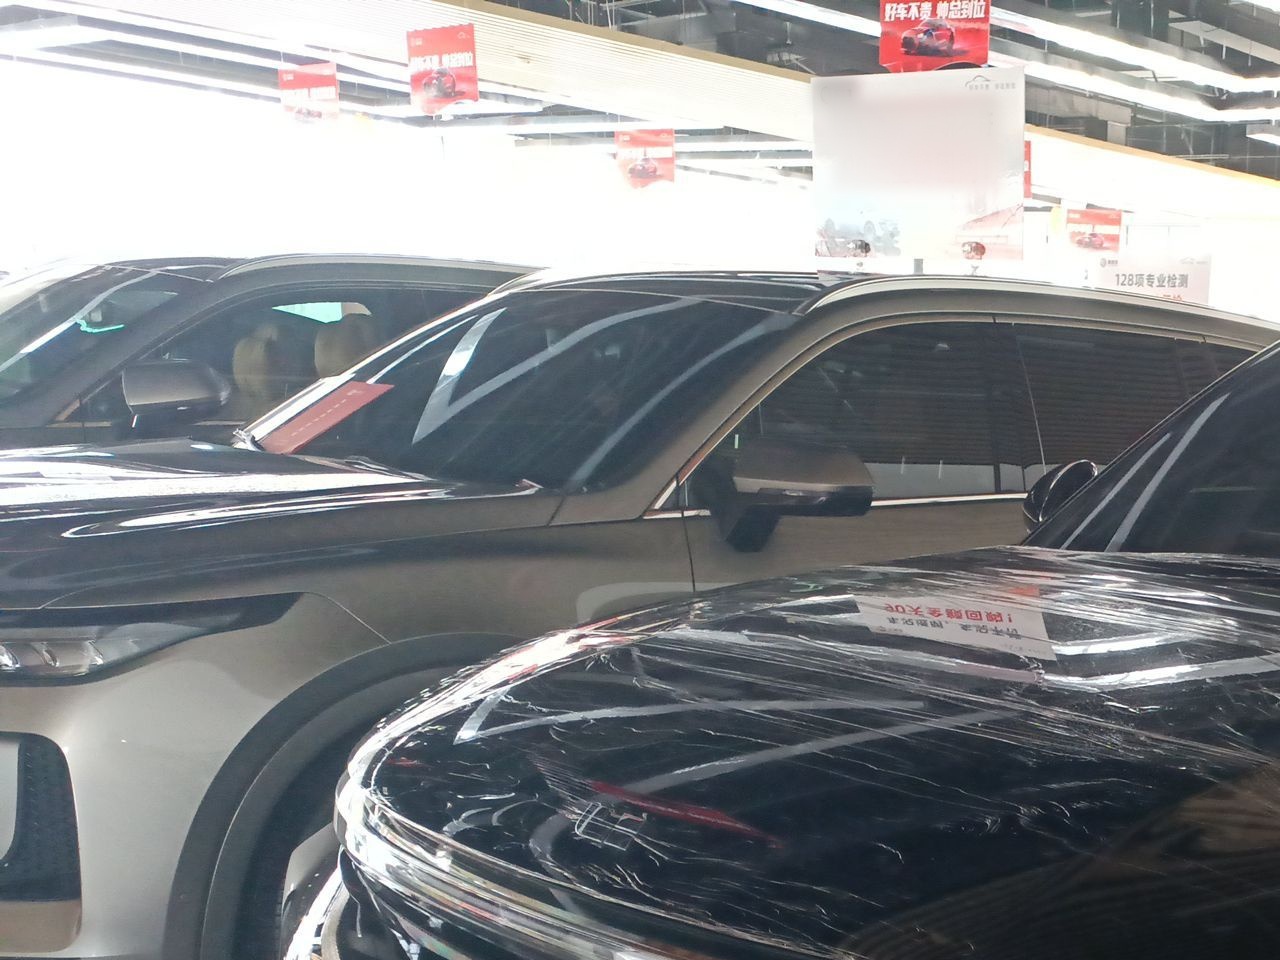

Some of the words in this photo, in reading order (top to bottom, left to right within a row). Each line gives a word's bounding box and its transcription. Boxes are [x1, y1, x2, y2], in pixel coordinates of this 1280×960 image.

[884, 2, 932, 21] 好车不贵
[936, 1, 986, 19] 帅总到位
[1115, 273, 1189, 288] 128项专业检测
